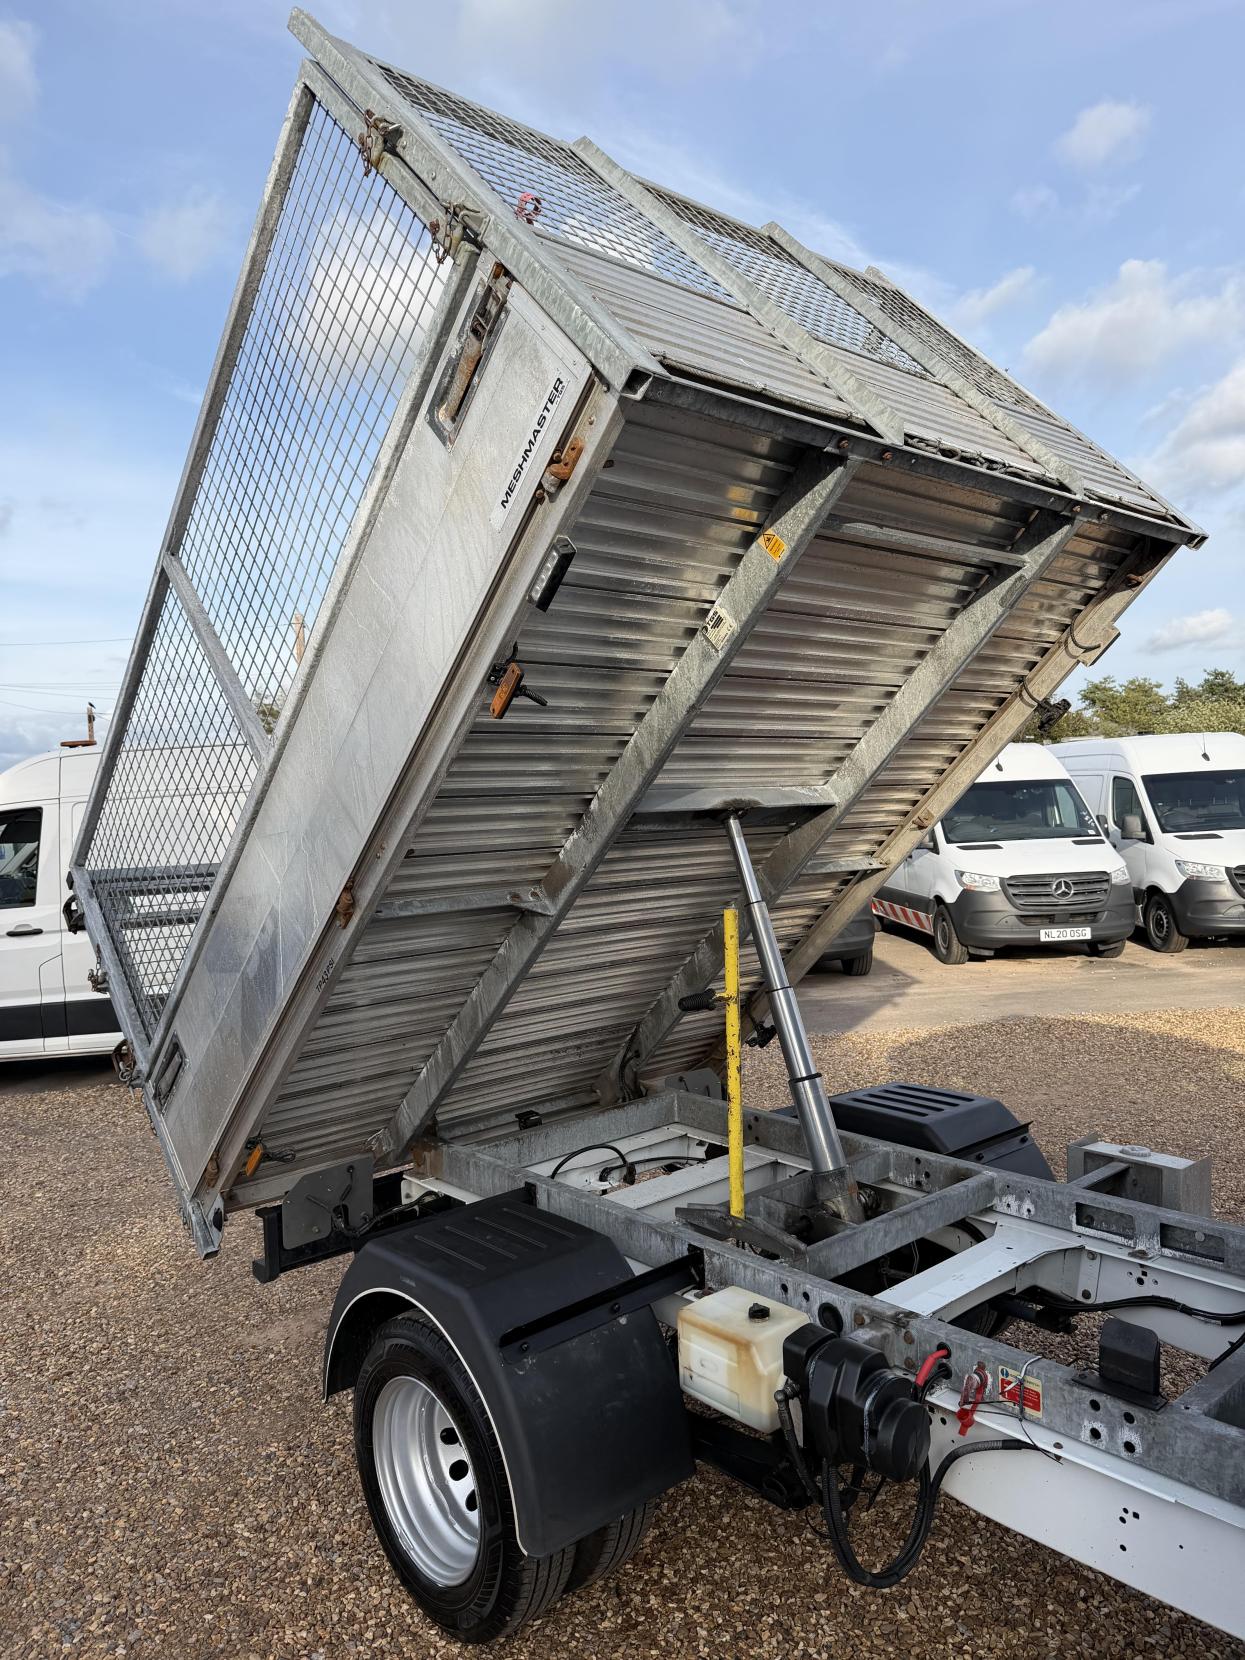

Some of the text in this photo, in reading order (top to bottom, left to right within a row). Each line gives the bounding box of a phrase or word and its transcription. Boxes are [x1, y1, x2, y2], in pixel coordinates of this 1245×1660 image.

[501, 377, 563, 509] MESHMASTER
[1044, 928, 1087, 939] NL20 OSG
